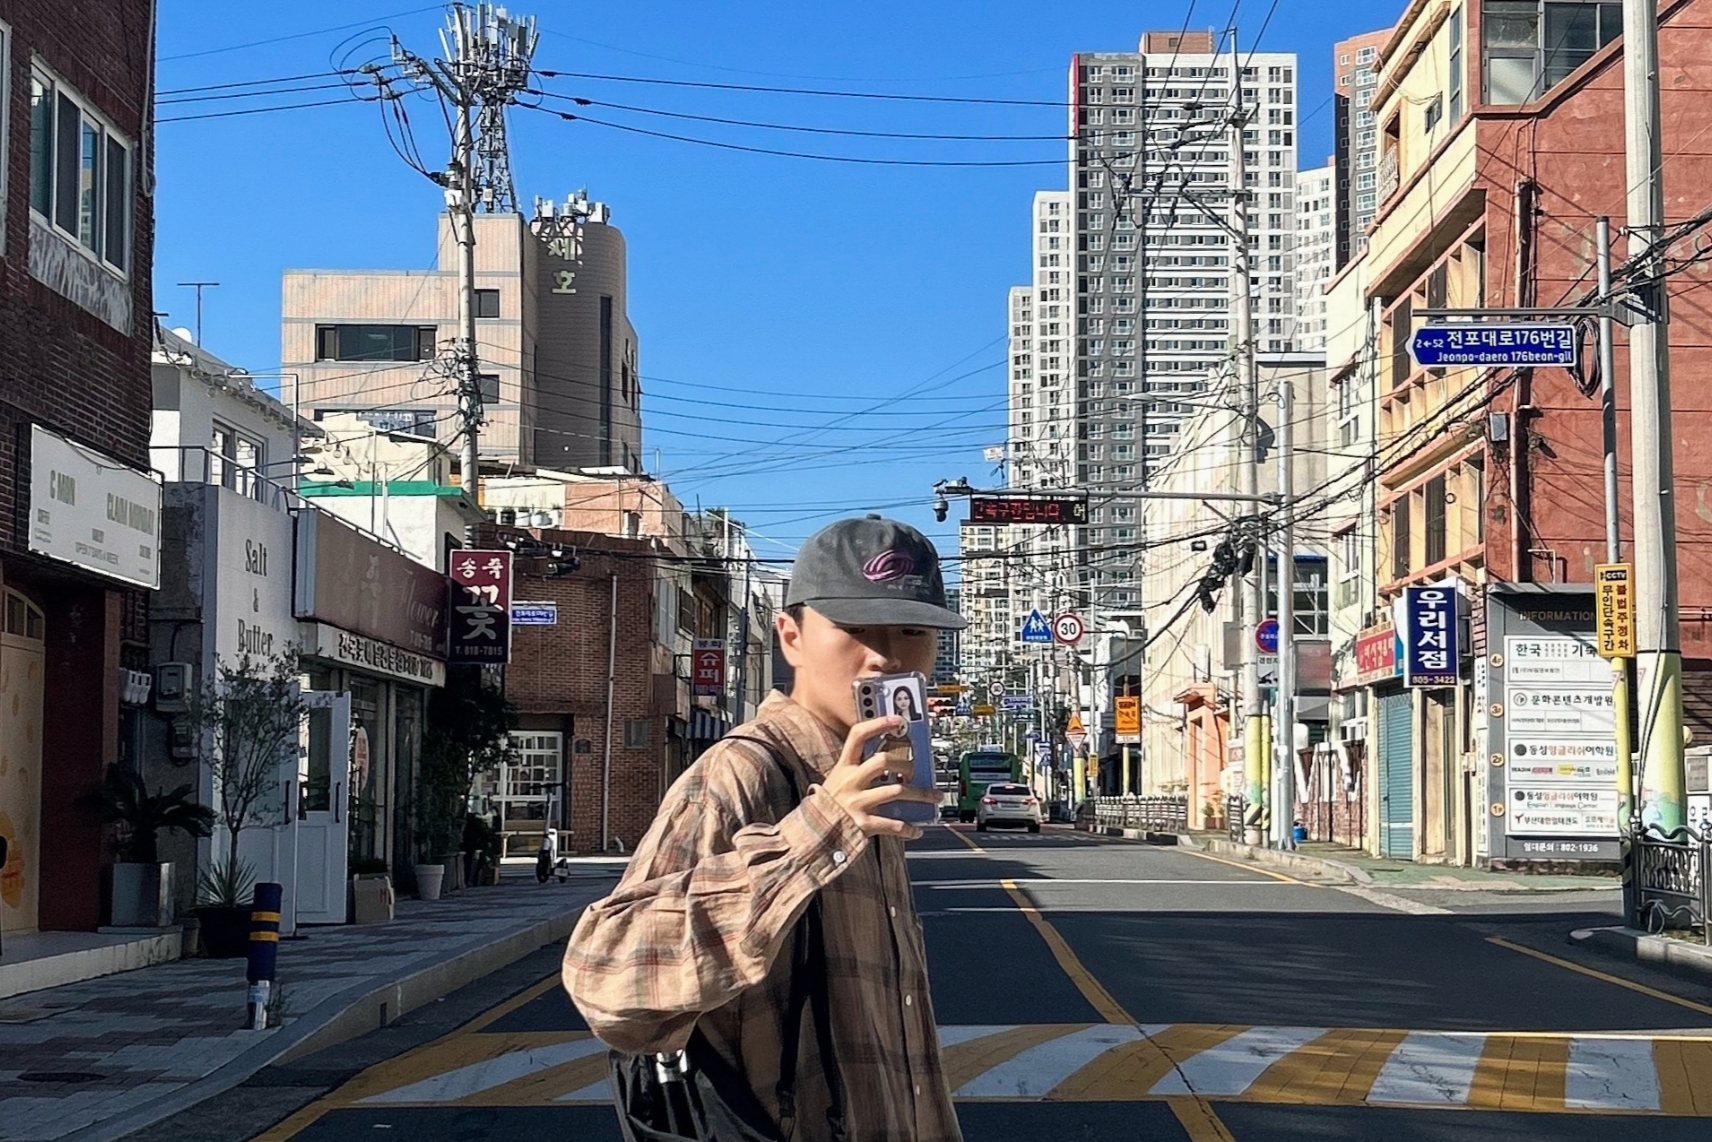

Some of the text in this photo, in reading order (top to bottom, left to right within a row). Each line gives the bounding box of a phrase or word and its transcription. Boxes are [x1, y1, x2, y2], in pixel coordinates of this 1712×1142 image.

[1416, 339, 1444, 348] 2 52
[1447, 330, 1573, 349] 전포대로176번길
[1437, 351, 1573, 364] Jeonpo-daero 176beon-gil
[245, 538, 267, 577] Salt
[456, 557, 504, 579] 송죽
[252, 587, 259, 613] &
[455, 584, 504, 640] 꽃
[1519, 611, 1596, 620] INFORMATION
[1602, 585, 1614, 651] 무인단속구간
[1616, 584, 1629, 650] 불법주정차
[238, 618, 273, 657] Butter
[1060, 622, 1077, 635] 30
[1416, 590, 1448, 669] 우리서점
[1515, 643, 1541, 657] 한국
[699, 652, 721, 683] 슈퍼
[1412, 675, 1455, 684] 805-3422
[1531, 695, 1613, 707] 문화콘텐츠개발원
[1523, 842, 1554, 852] 임대문의
[1560, 842, 1599, 852] 802-1936
